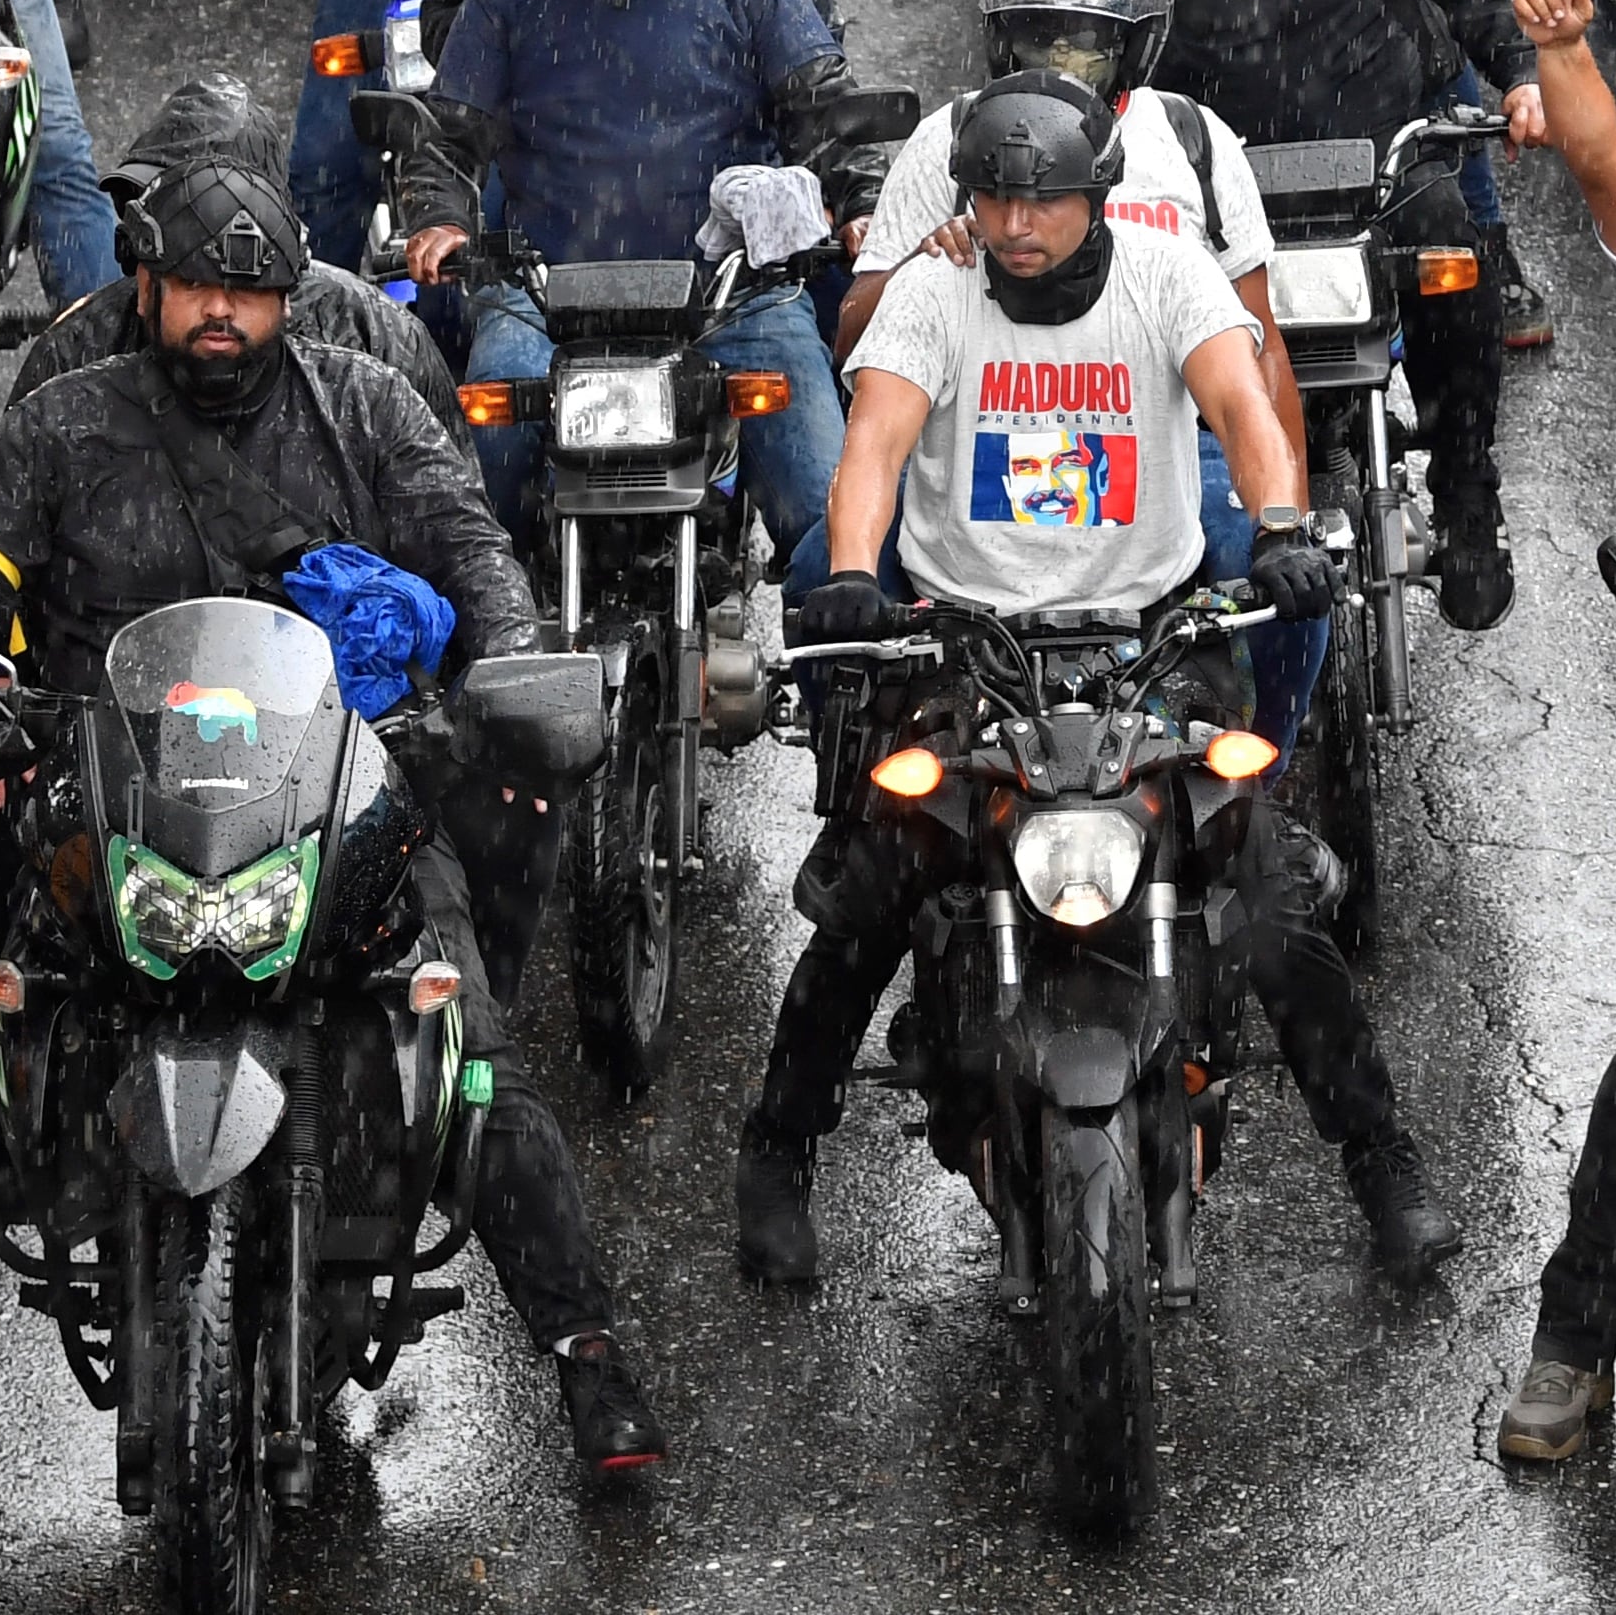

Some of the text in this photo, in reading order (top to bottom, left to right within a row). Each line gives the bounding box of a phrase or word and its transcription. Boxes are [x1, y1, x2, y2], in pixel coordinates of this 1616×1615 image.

[979, 360, 1133, 414] MADURO
[977, 414, 1135, 428] PRESIDENTE
[181, 776, 249, 791] Kawasaki
